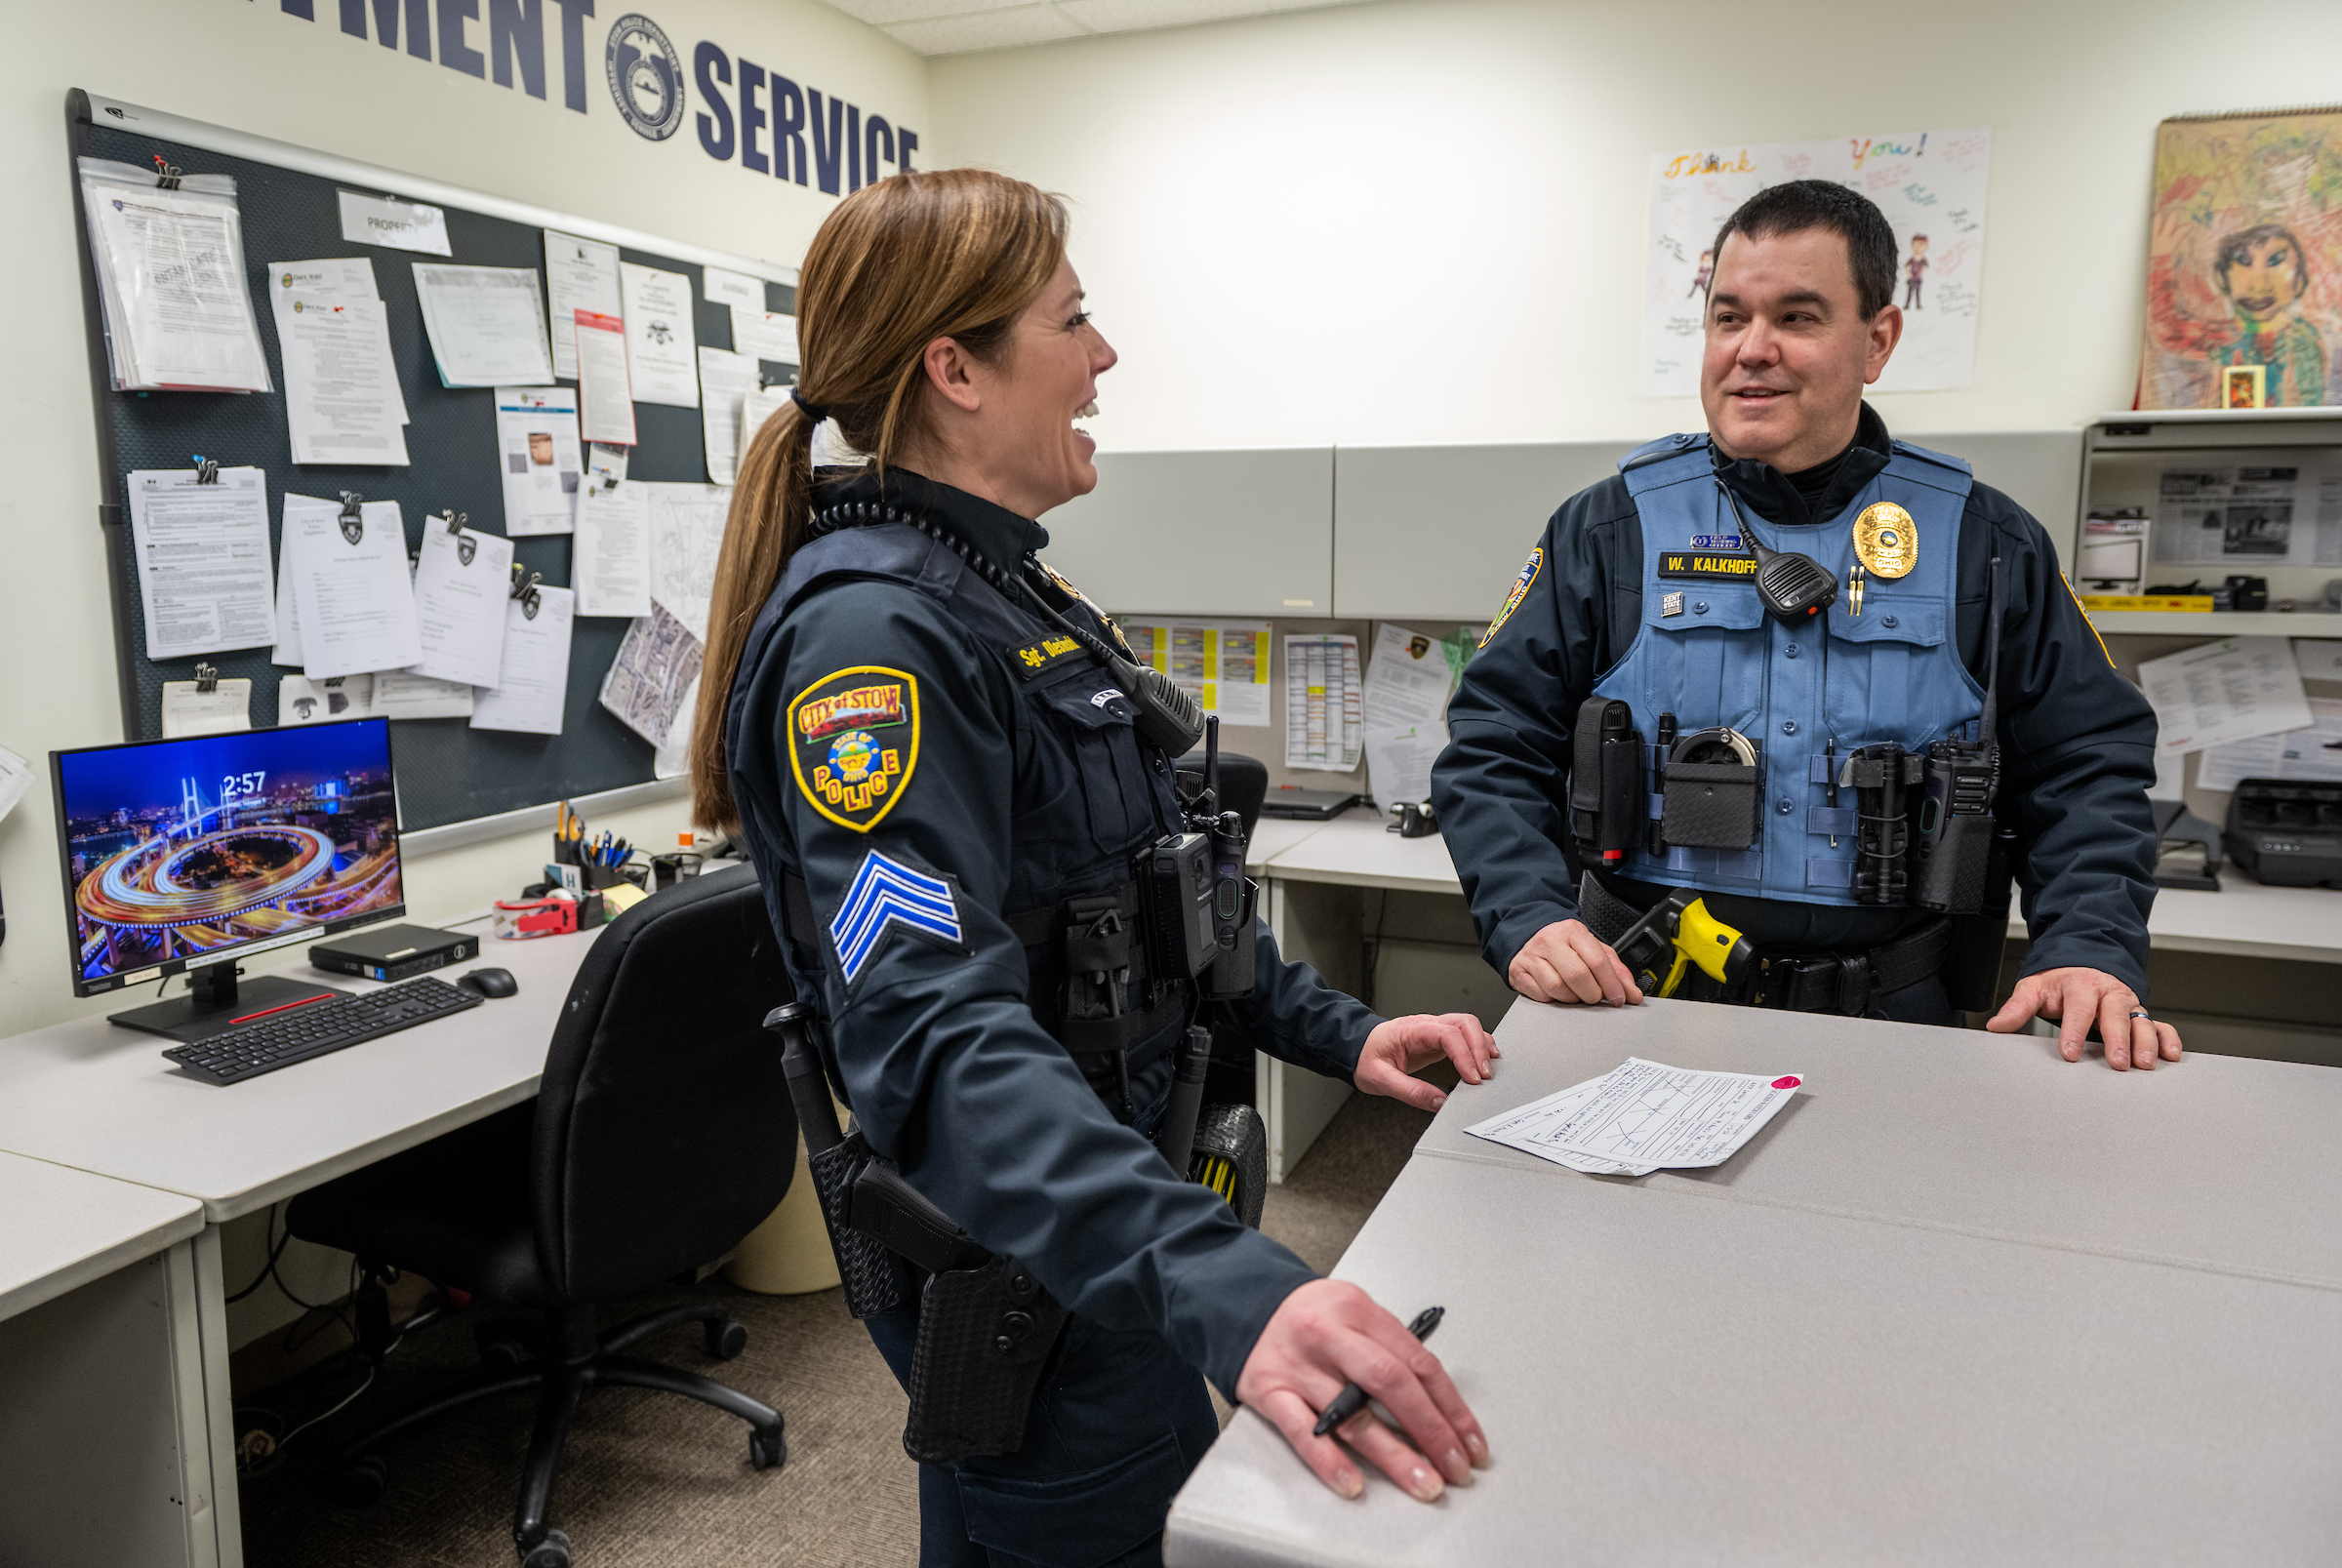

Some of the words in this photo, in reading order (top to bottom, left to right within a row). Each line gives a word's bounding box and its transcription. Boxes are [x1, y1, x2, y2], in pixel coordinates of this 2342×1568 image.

[280, 0, 595, 114] MENT
[1664, 149, 1756, 179] Thank
[367, 217, 419, 234] PROPERTY
[1668, 556, 1685, 571] W.
[1693, 557, 1757, 574] KALKHOFF
[1663, 593, 1681, 603] KENT
[1020, 647, 1046, 667] Sgt.
[800, 700, 833, 732] CITY
[834, 694, 848, 709] of
[850, 685, 899, 722] STOW
[831, 731, 857, 751] STATE
[858, 732, 873, 744] OF
[222, 771, 266, 797] 2:57
[814, 749, 900, 812] POLICE
[842, 768, 868, 783] OHIO
